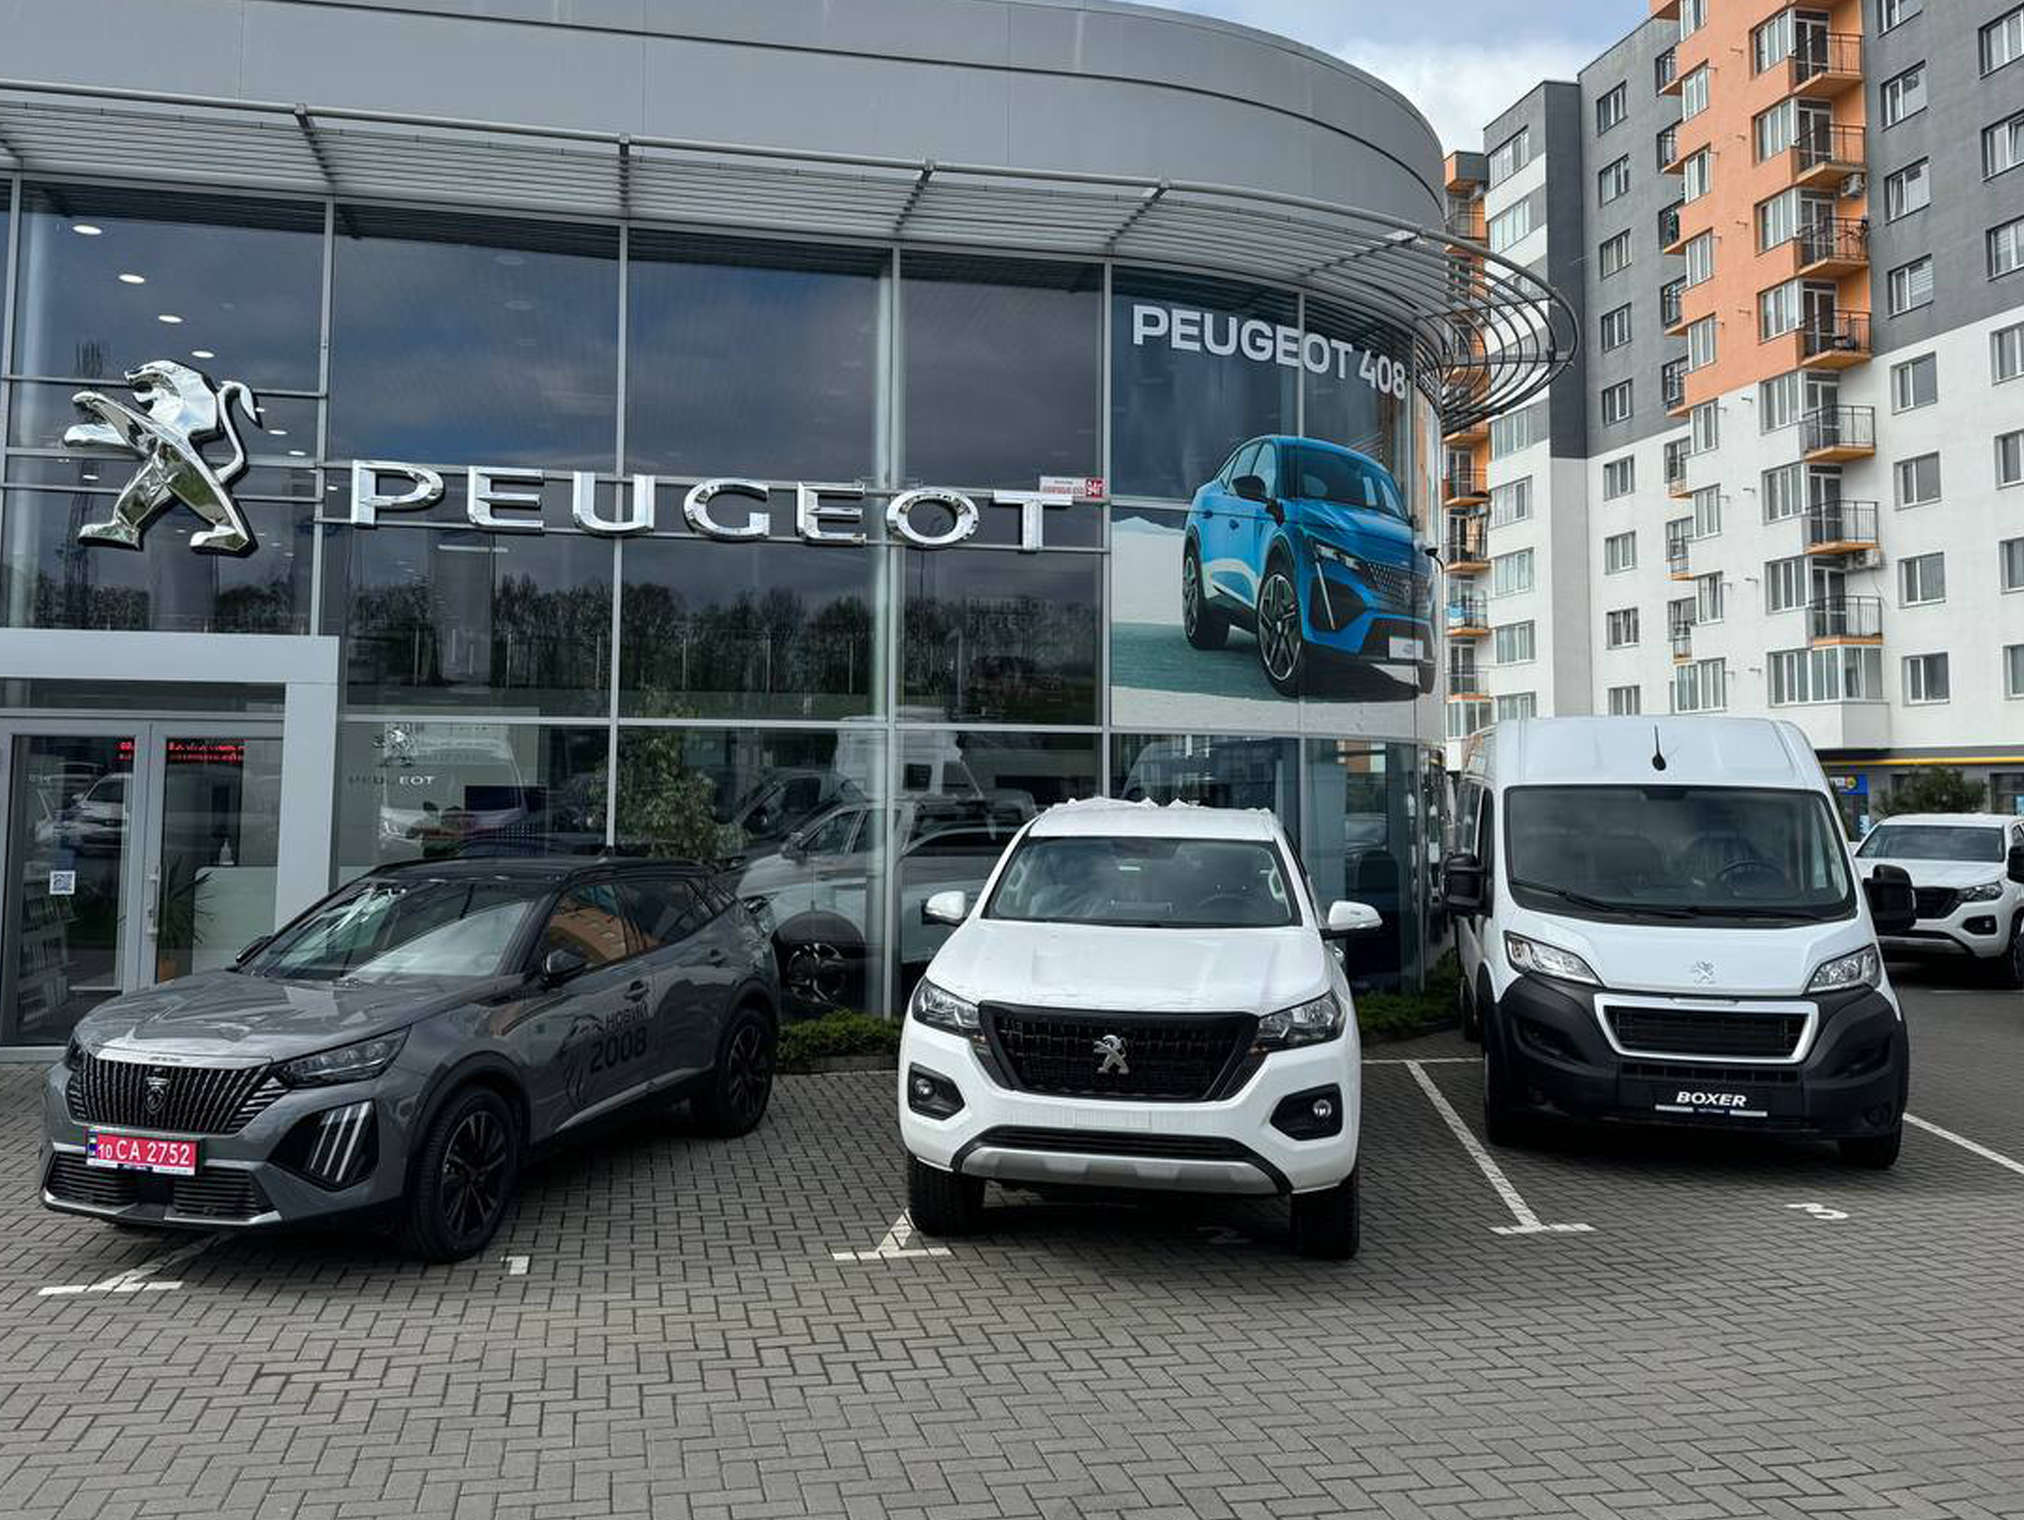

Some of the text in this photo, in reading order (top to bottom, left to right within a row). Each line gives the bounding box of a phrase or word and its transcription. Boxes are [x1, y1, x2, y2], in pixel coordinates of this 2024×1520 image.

[1132, 304, 1406, 400] PEUGEOT 408
[350, 459, 1073, 551] PEUGEOT
[590, 1024, 647, 1074] 2008
[1676, 1091, 1747, 1107] BOXER
[116, 1140, 141, 1161] CA
[146, 1141, 190, 1165] 2752
